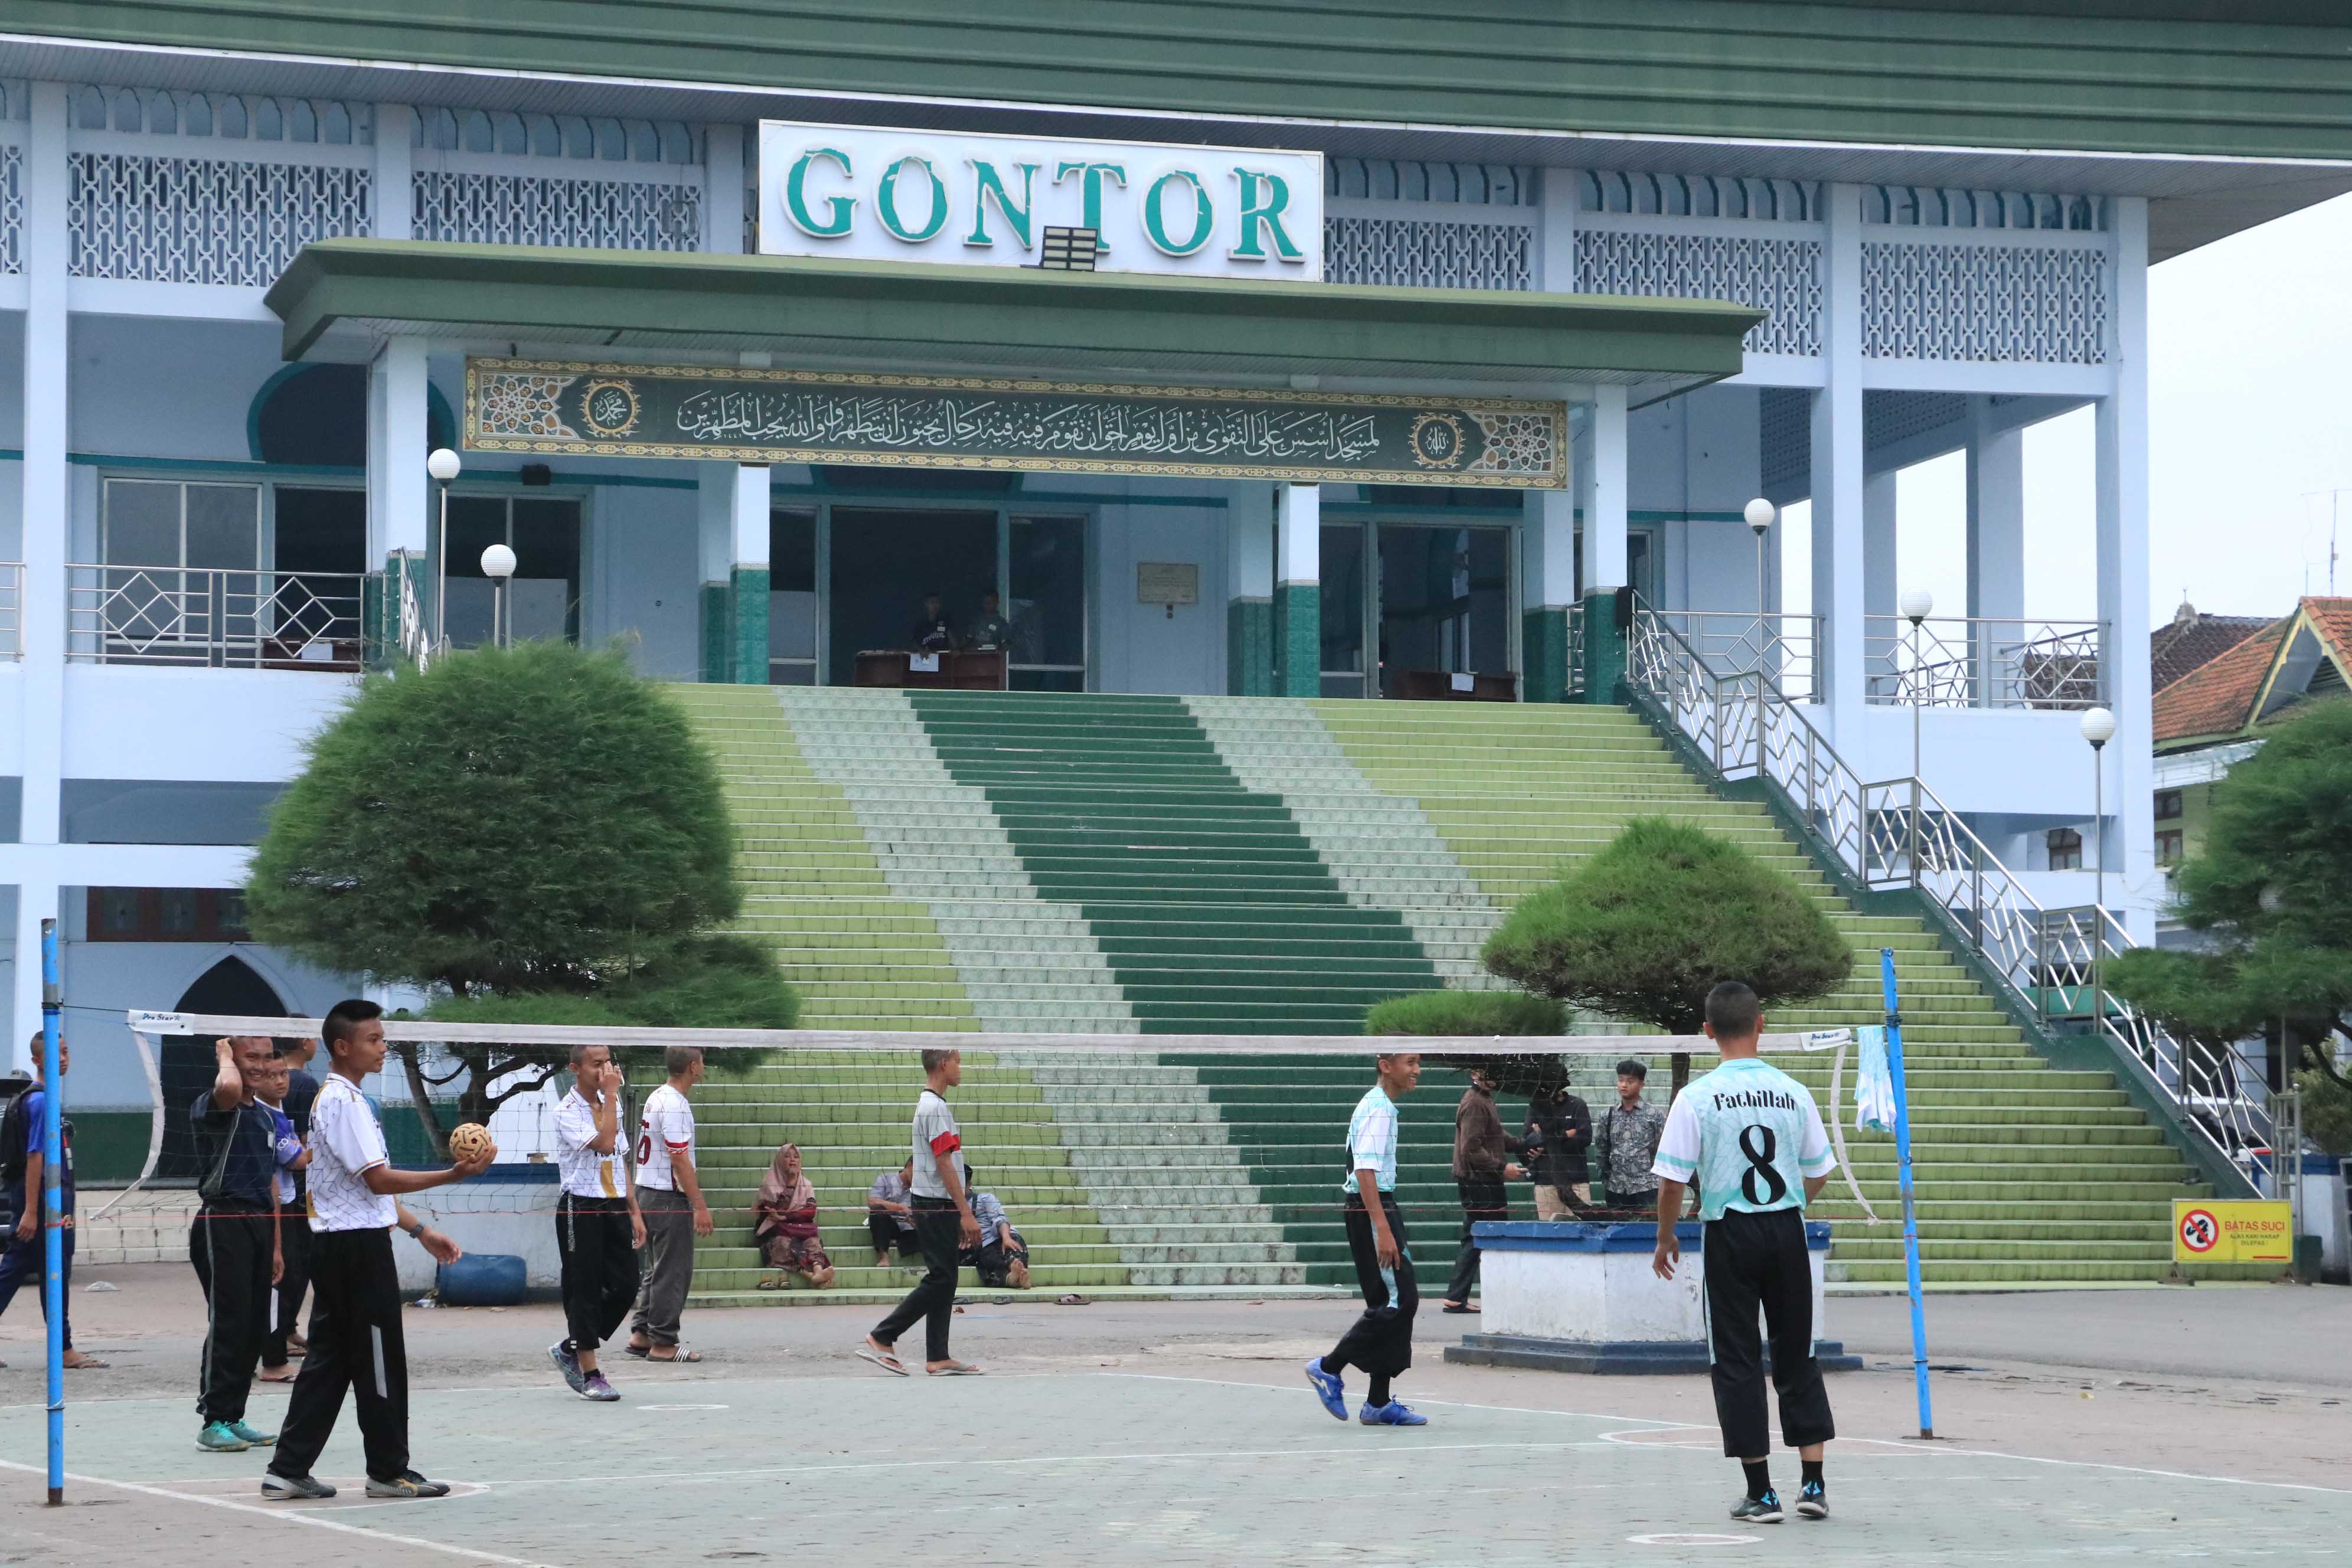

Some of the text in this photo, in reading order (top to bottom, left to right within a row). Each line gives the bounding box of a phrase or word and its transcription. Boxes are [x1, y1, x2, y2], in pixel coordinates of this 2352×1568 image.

[782, 146, 1306, 263] GONTOR
[1713, 1089, 1795, 1112] Fathillah
[1739, 1124, 1787, 1206] 8
[2224, 1221, 2285, 1231] BATAS SUCI
